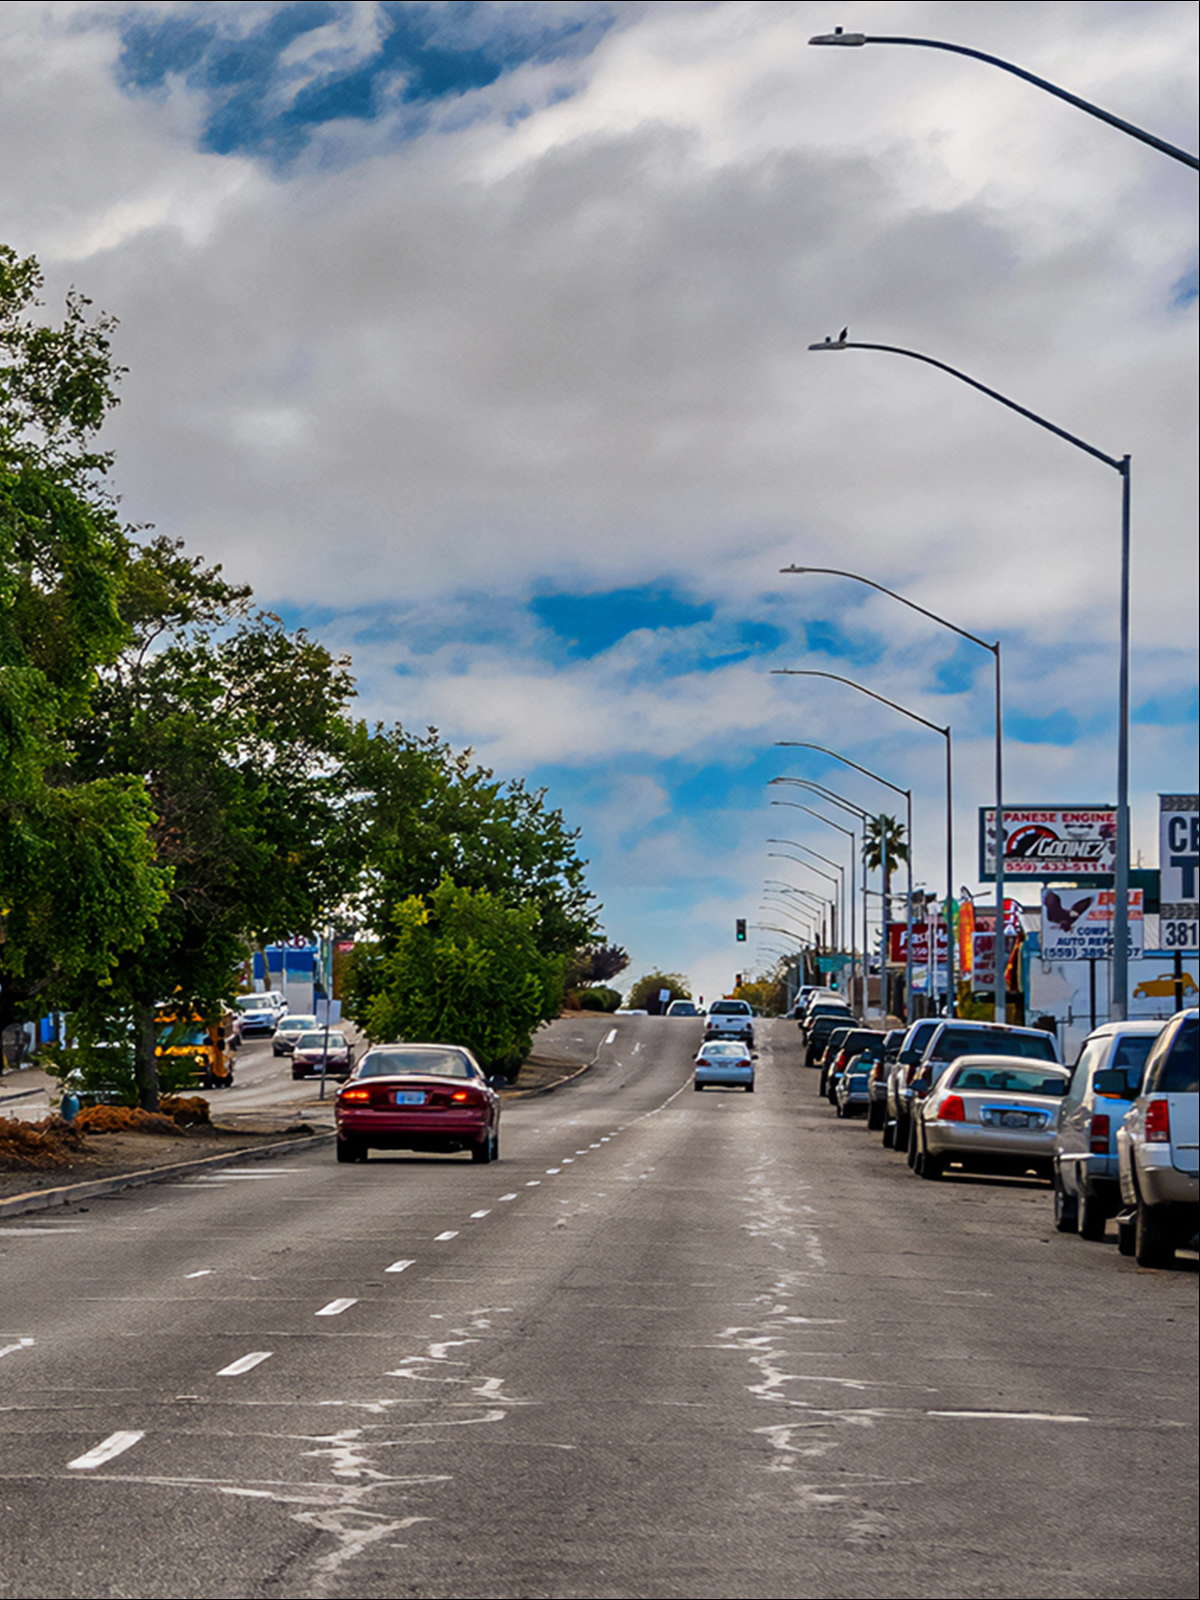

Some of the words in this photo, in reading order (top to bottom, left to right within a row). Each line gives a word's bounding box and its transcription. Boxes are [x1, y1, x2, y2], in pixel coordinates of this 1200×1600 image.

[986, 812, 1057, 823] JPANESE
[1061, 812, 1117, 823] ENGINE
[1000, 863, 1037, 873] 559)
[1056, 937, 1086, 946] AUTO
